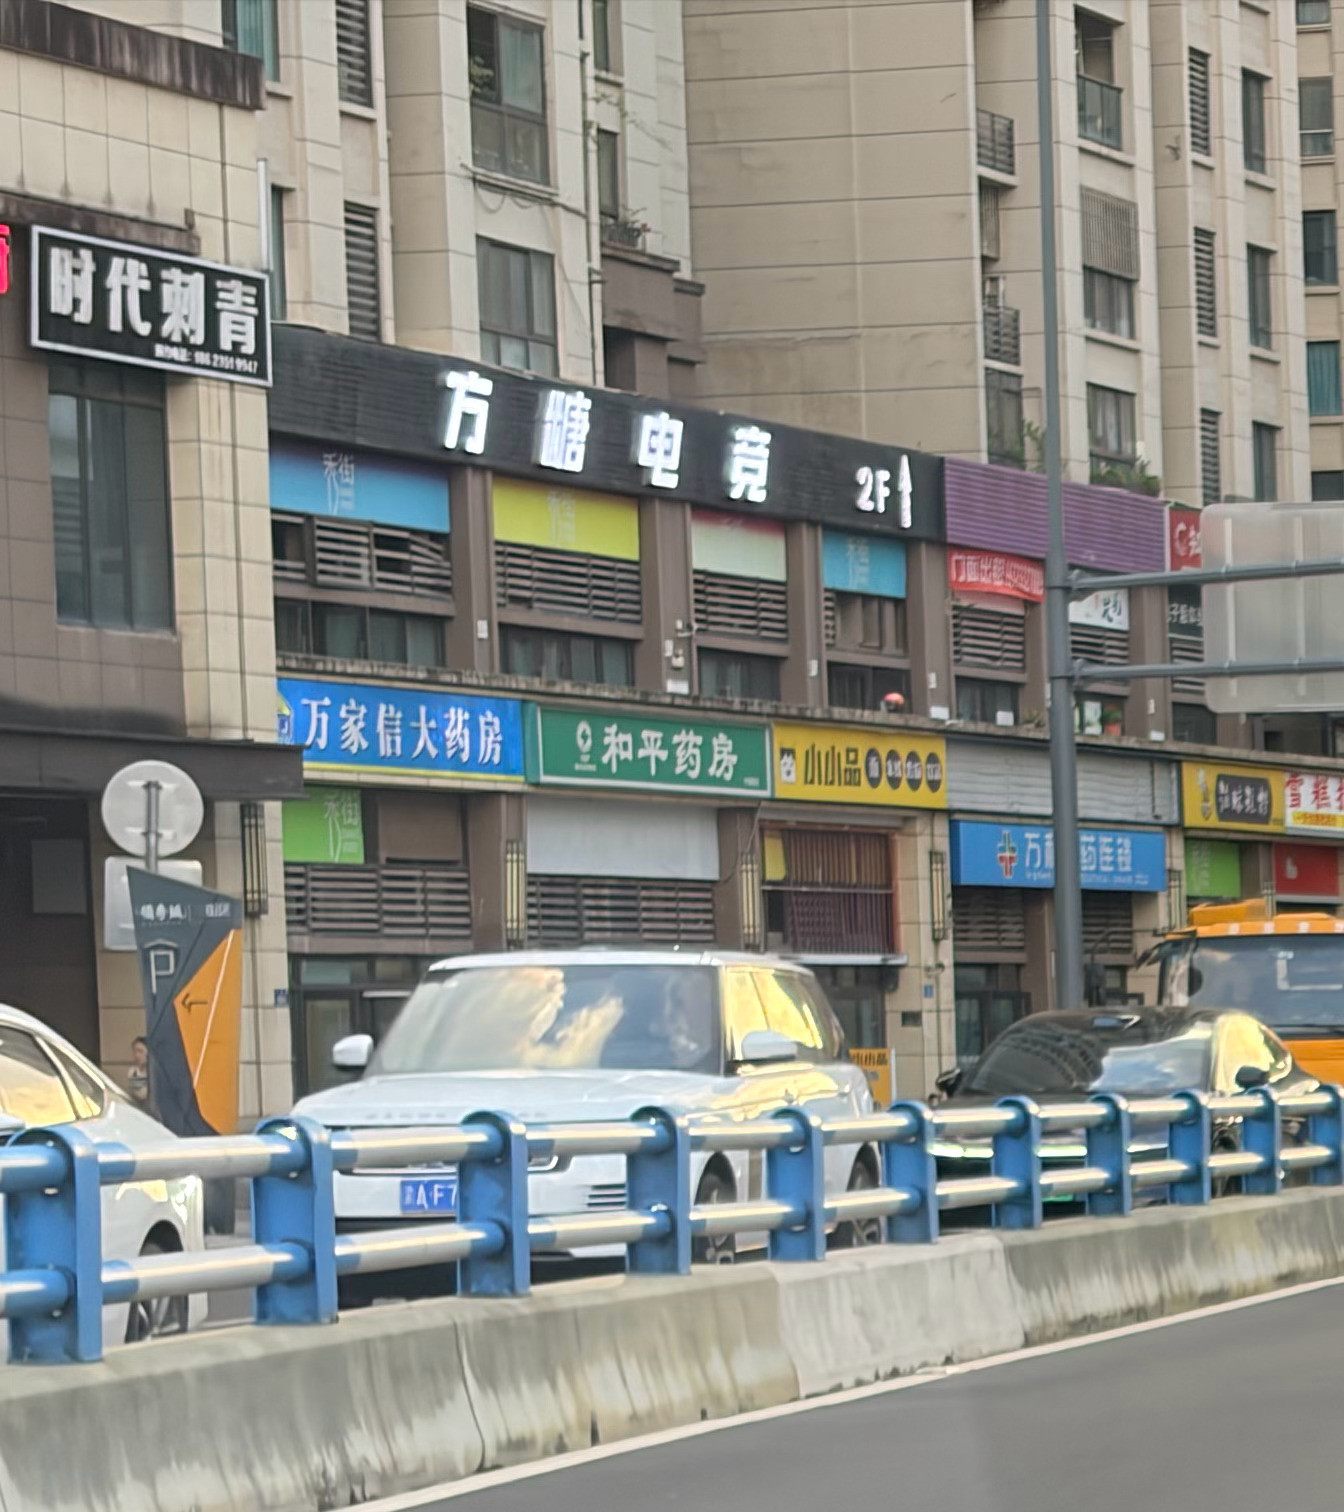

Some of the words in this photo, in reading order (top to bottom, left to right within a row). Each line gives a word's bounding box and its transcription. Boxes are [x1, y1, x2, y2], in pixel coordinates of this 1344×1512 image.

[49, 246, 259, 355] 时代刺青
[855, 466, 891, 513] 2F
[302, 697, 502, 765] 万家信大药房
[601, 723, 738, 781] 和平药房
[1024, 832, 1132, 872] 万药连锁
